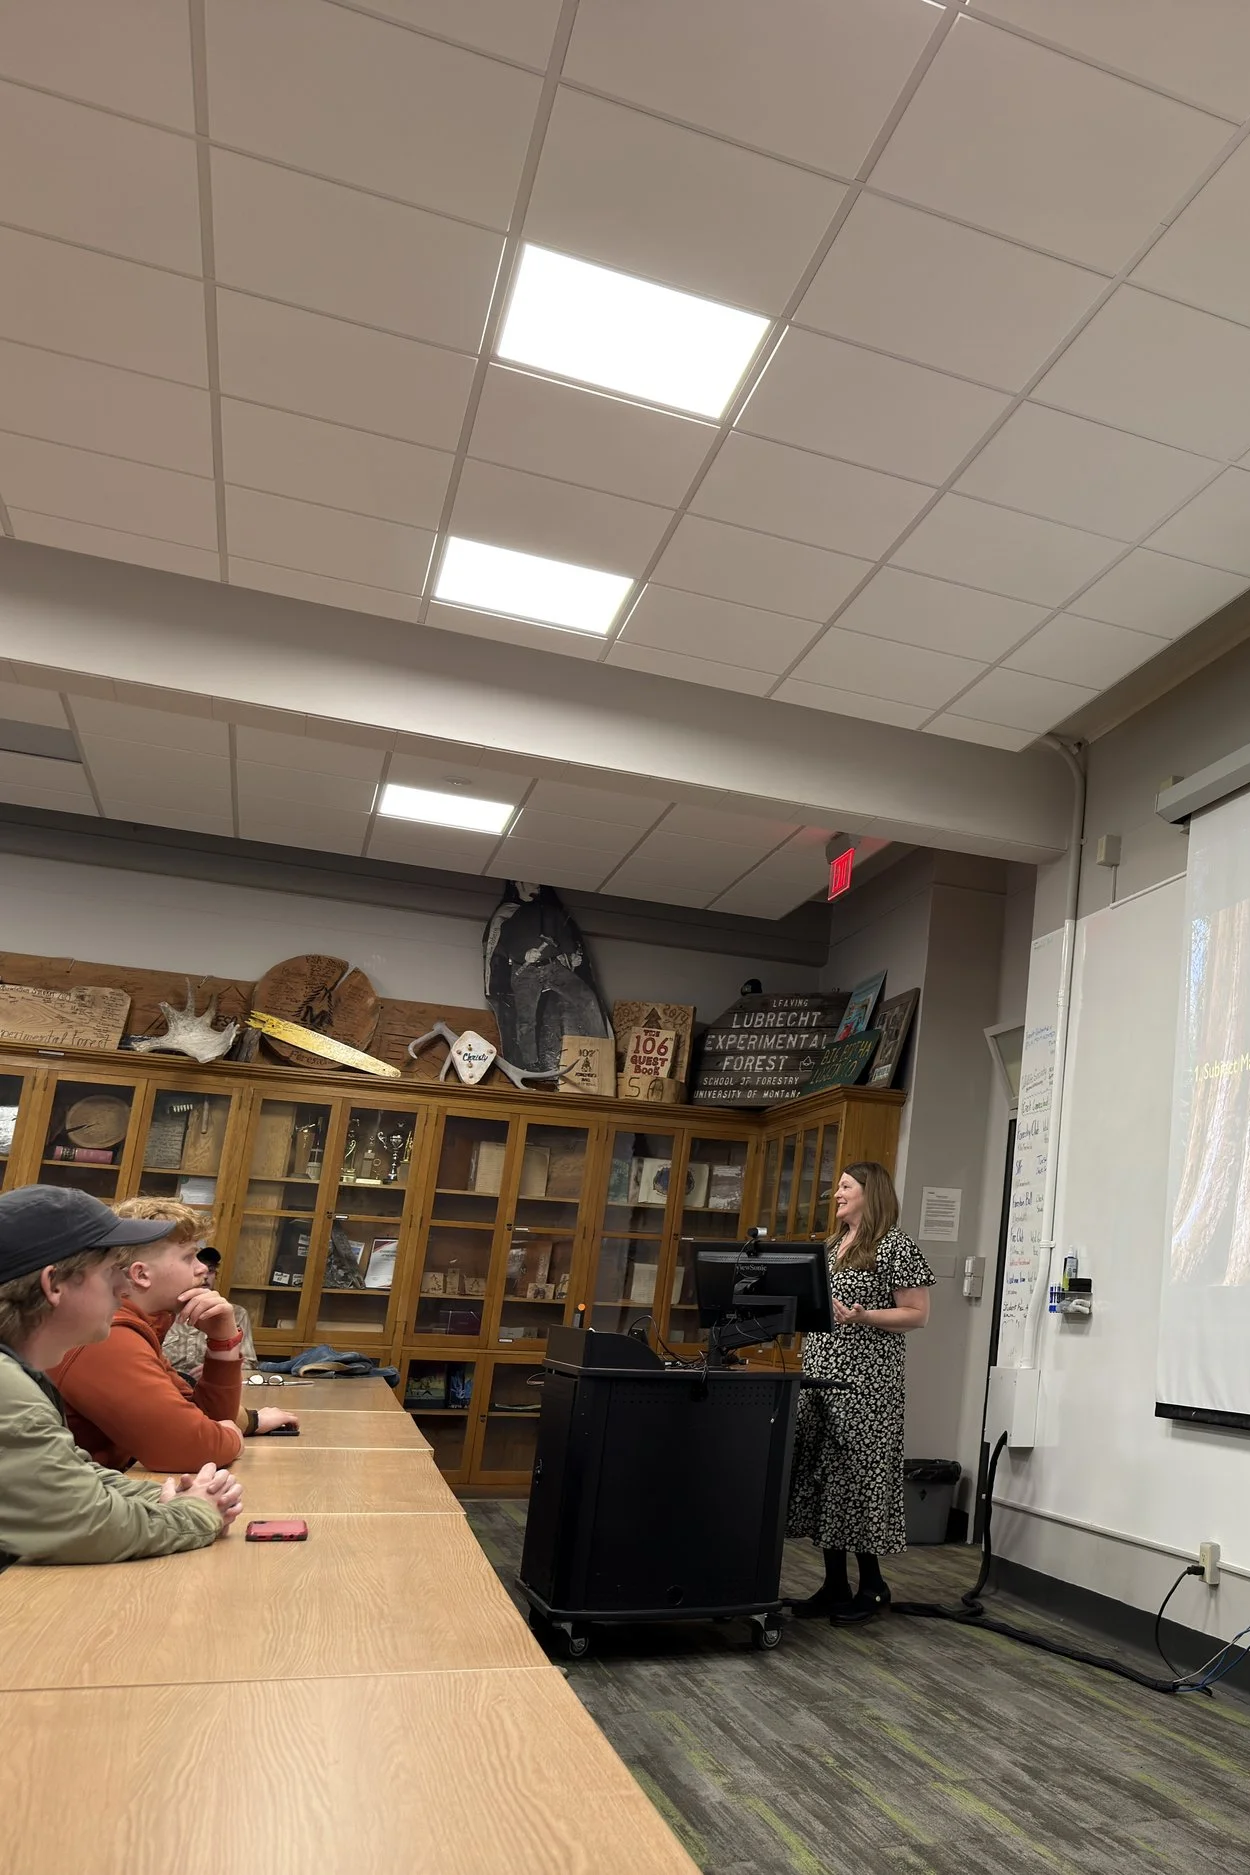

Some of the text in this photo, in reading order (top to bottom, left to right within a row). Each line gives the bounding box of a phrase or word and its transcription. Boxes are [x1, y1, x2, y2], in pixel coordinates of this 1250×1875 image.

[732, 1011, 821, 1029] LUBRECHT
[704, 1033, 826, 1051] EXPERIMENTAL
[630, 1054, 669, 1067] GUEST
[722, 1055, 788, 1073] FOREST
[1203, 1059, 1238, 1080] Subject
[703, 1076, 734, 1086] SCHOOL
[756, 1076, 799, 1086] FORESTRY
[693, 1089, 741, 1099] UNIVERSITY
[747, 1089, 758, 1099] OF
